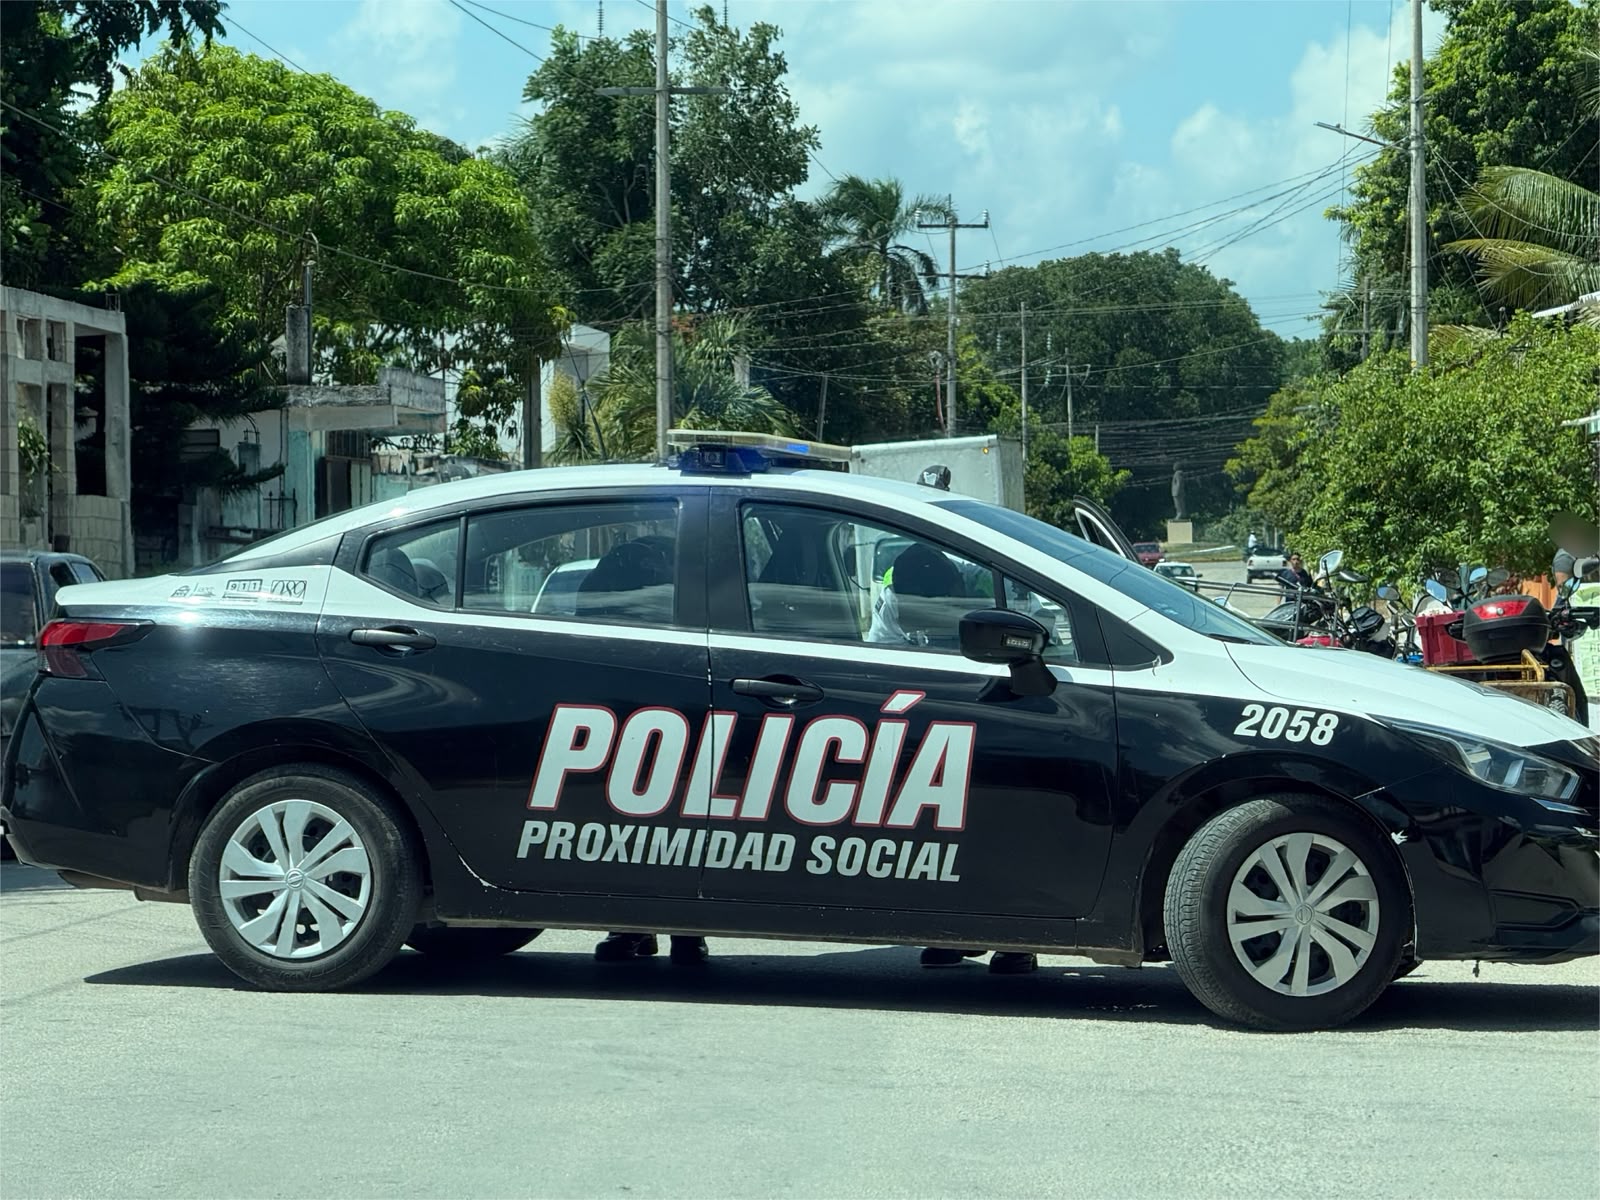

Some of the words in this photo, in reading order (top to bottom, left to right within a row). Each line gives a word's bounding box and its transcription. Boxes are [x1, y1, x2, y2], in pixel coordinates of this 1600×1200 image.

[1233, 703, 1339, 746] 2058
[526, 690, 977, 831] POLICÍA
[516, 820, 796, 872] PROXIMIDAD
[806, 835, 960, 882] SOCIAL
